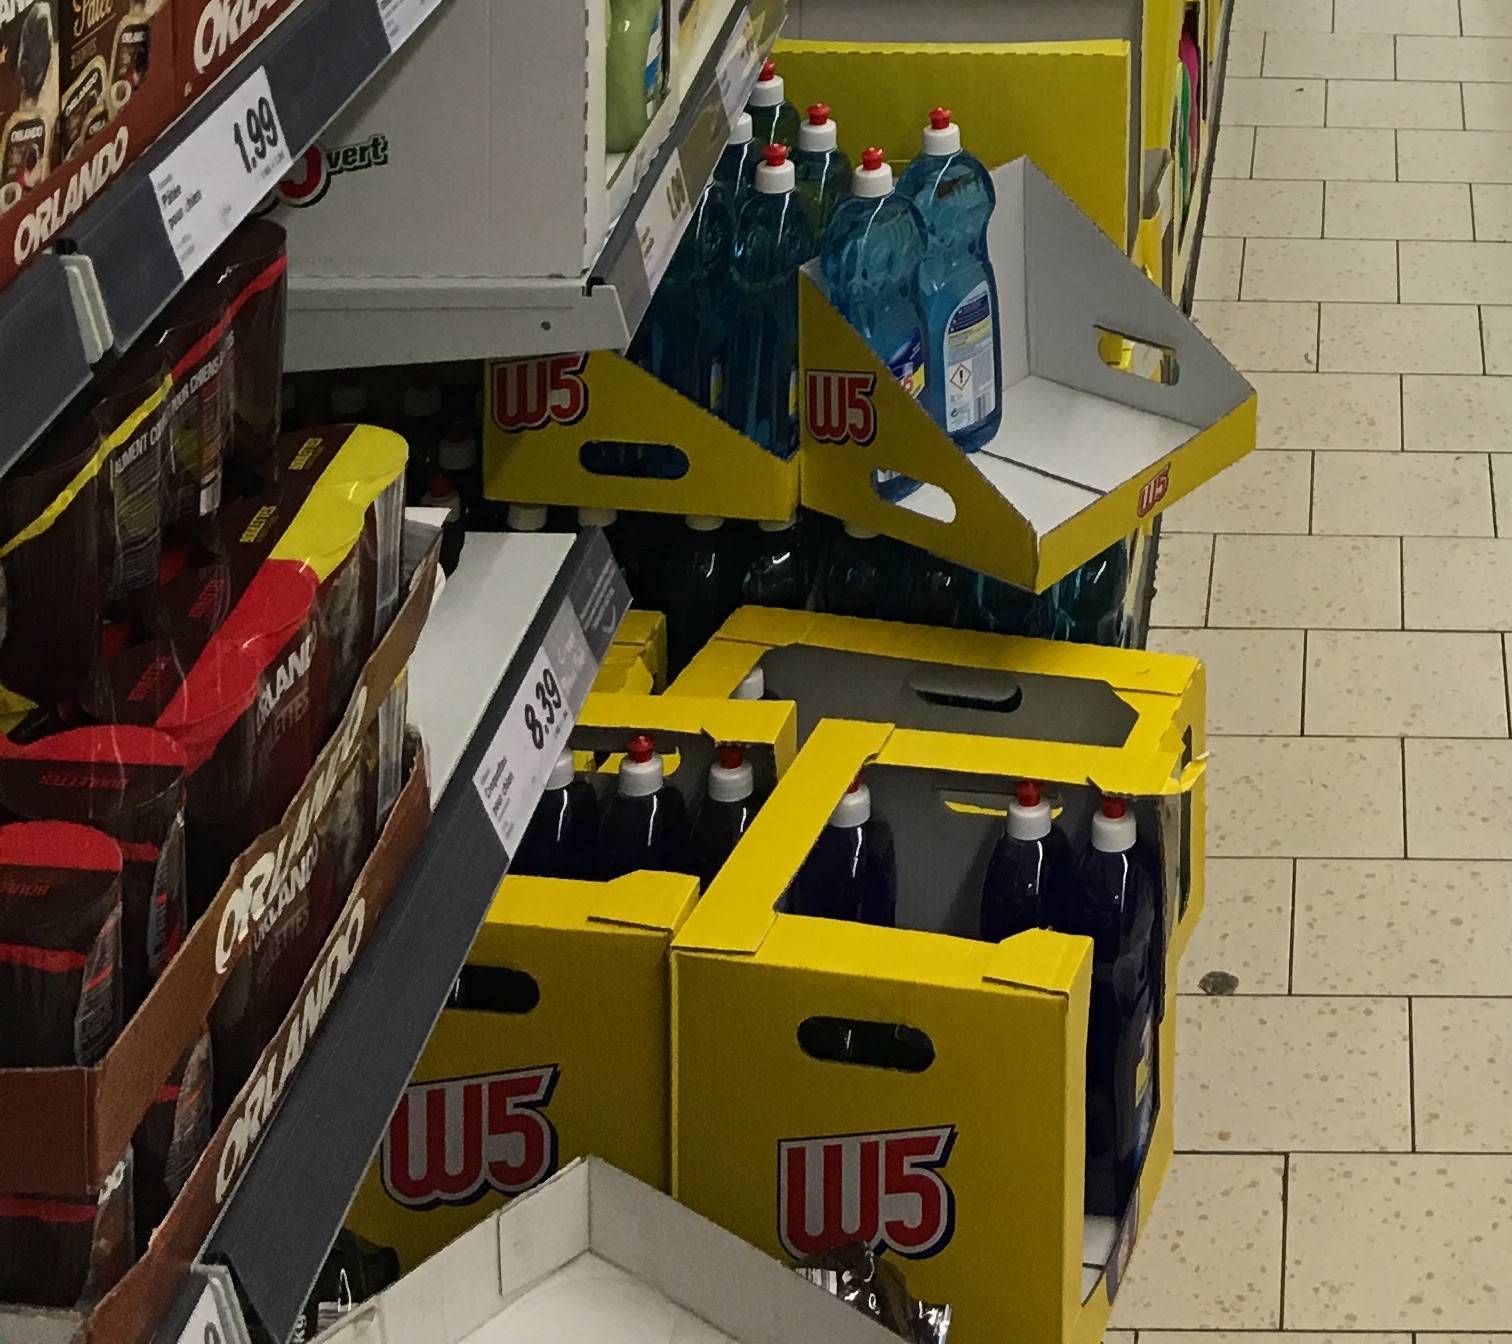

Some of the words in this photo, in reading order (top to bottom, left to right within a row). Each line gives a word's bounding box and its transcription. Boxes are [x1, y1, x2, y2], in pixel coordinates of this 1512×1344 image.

[10, 126, 43, 143] ORLANDO
[233, 96, 279, 174] 1.99
[13, 125, 129, 265] ORLANDO
[492, 352, 585, 429] W5
[805, 370, 876, 443] W5
[1136, 462, 1171, 517] W5
[524, 668, 563, 750] 8.39
[215, 898, 367, 1204] ORLANDO
[382, 1066, 558, 1208] W5
[780, 1127, 955, 1259] W5
